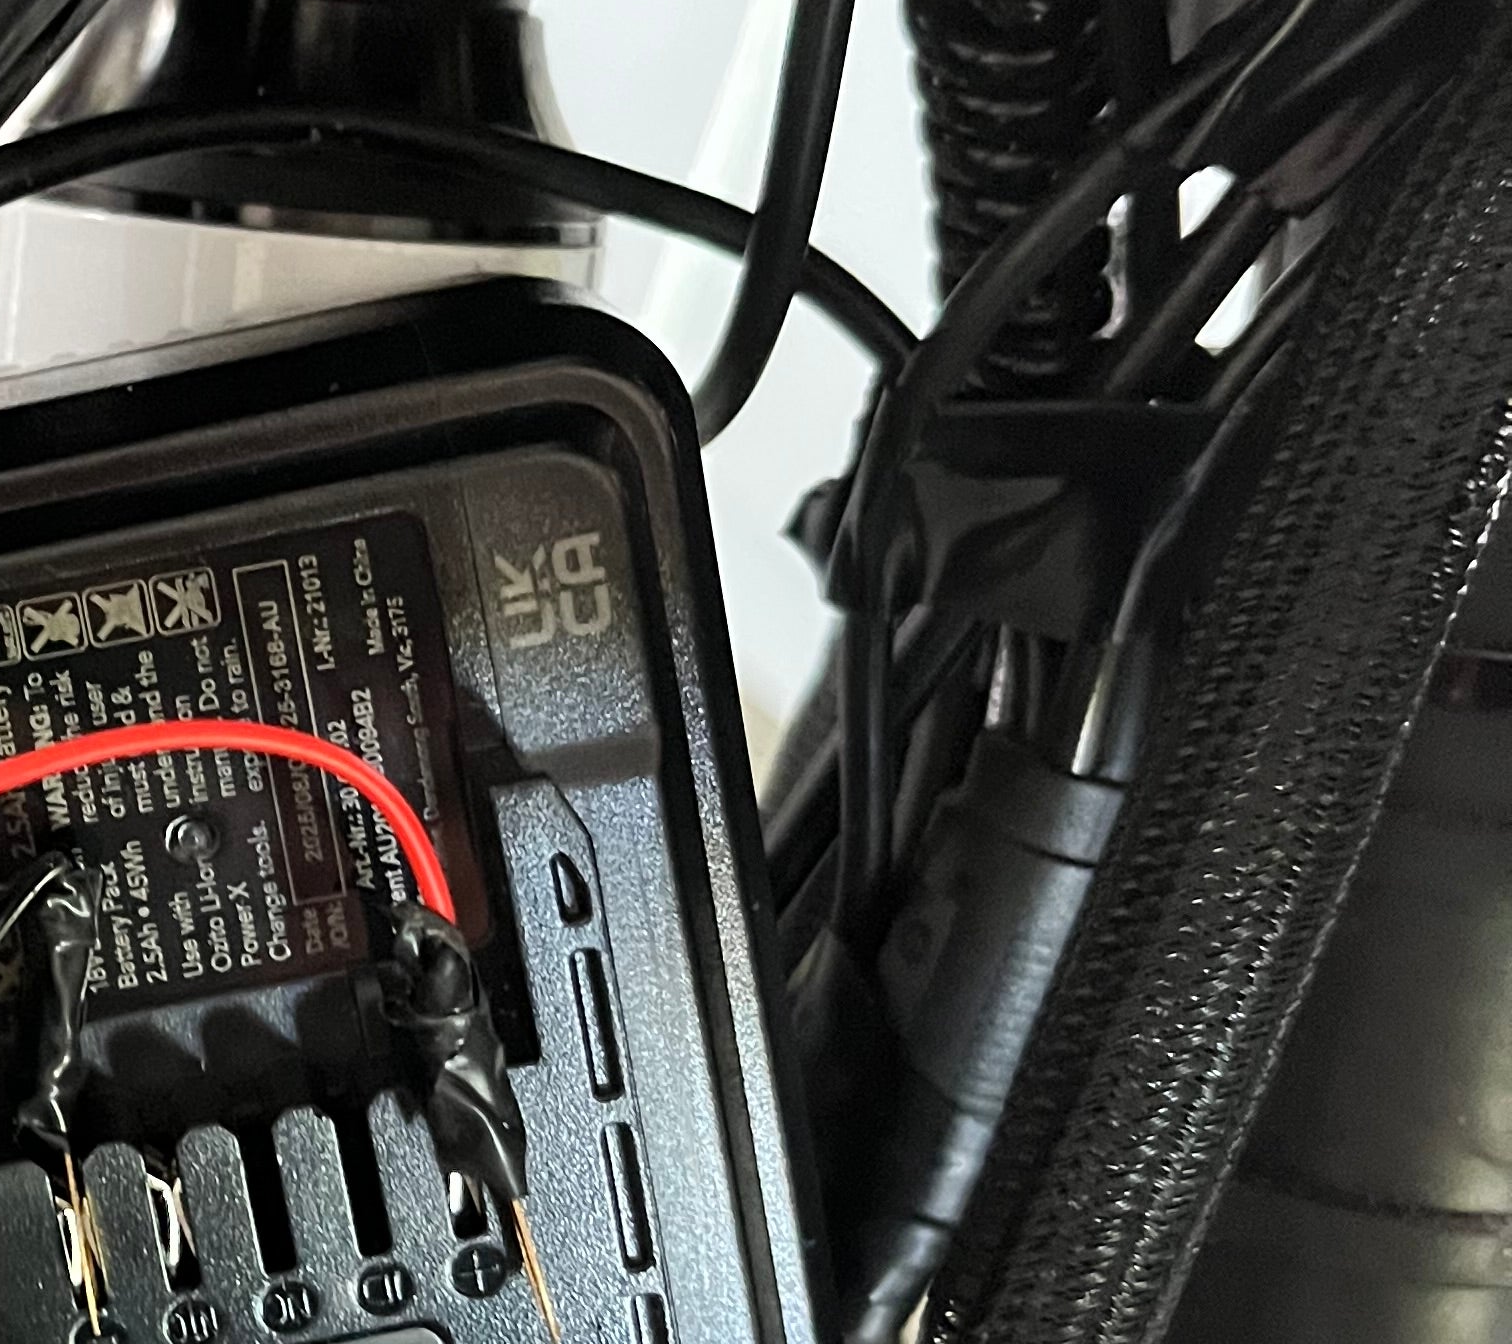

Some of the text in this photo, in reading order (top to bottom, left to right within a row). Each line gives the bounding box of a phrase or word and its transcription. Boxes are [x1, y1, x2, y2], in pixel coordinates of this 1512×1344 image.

[297, 553, 325, 614] 21013
[349, 537, 372, 586] China
[361, 607, 384, 655] Made
[386, 595, 408, 637] 3175
[131, 649, 157, 687] the
[189, 635, 212, 673] not
[217, 637, 244, 685] rain.
[48, 670, 75, 707] risk
[85, 679, 107, 725] user
[194, 677, 219, 711] Do
[228, 687, 249, 713] to
[21, 671, 70, 829] WARNG: To
[67, 763, 98, 824] reduc
[101, 794, 124, 819] of
[127, 760, 153, 814] must
[119, 839, 167, 984] 2.5Ah 45Wh
[244, 819, 296, 962] Change tools.
[106, 913, 143, 989] Battery
[167, 890, 203, 977] Use with
[203, 915, 232, 973] Ozito
[231, 902, 262, 967] Power
[299, 907, 323, 953] Date
